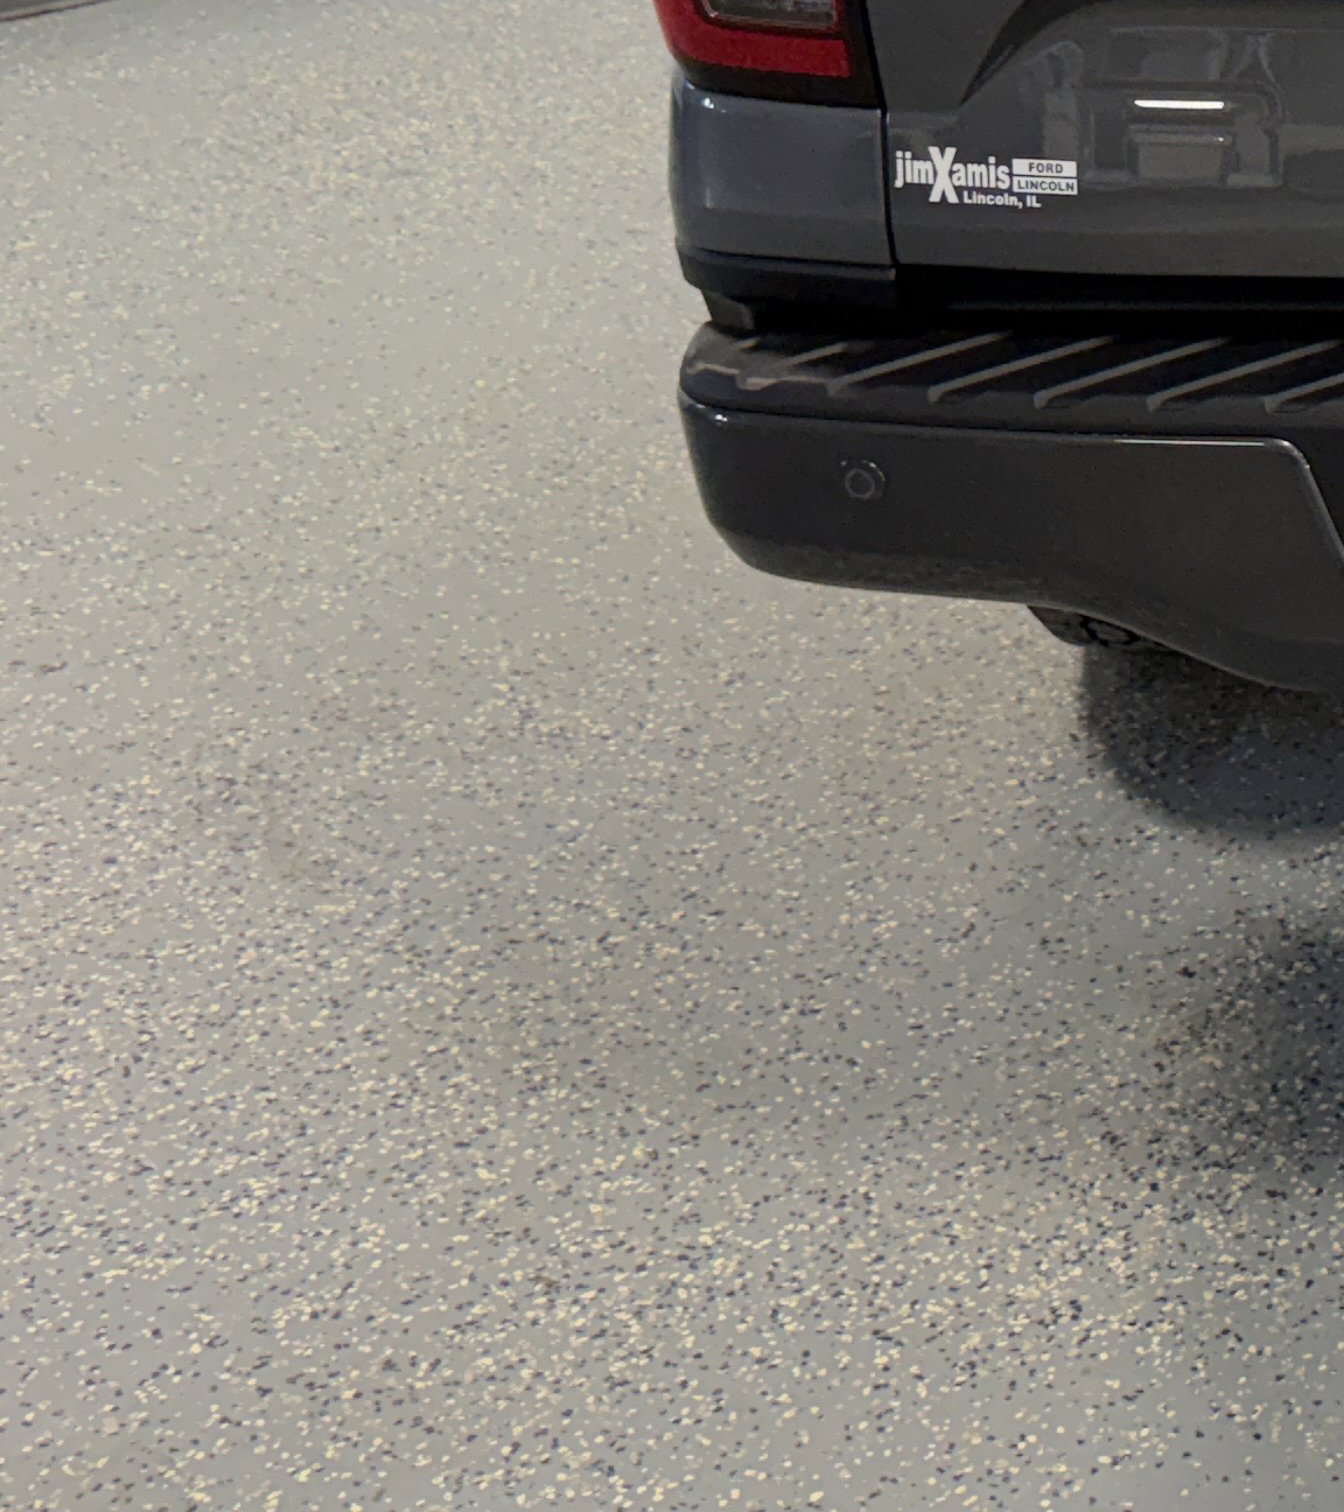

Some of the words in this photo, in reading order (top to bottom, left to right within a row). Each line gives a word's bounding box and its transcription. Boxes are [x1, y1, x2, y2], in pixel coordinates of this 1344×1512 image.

[1028, 161, 1064, 175] FORD
[1016, 180, 1075, 192] LINCOLN
[962, 190, 1023, 209] Lincoln,
[1026, 194, 1042, 208] IL
